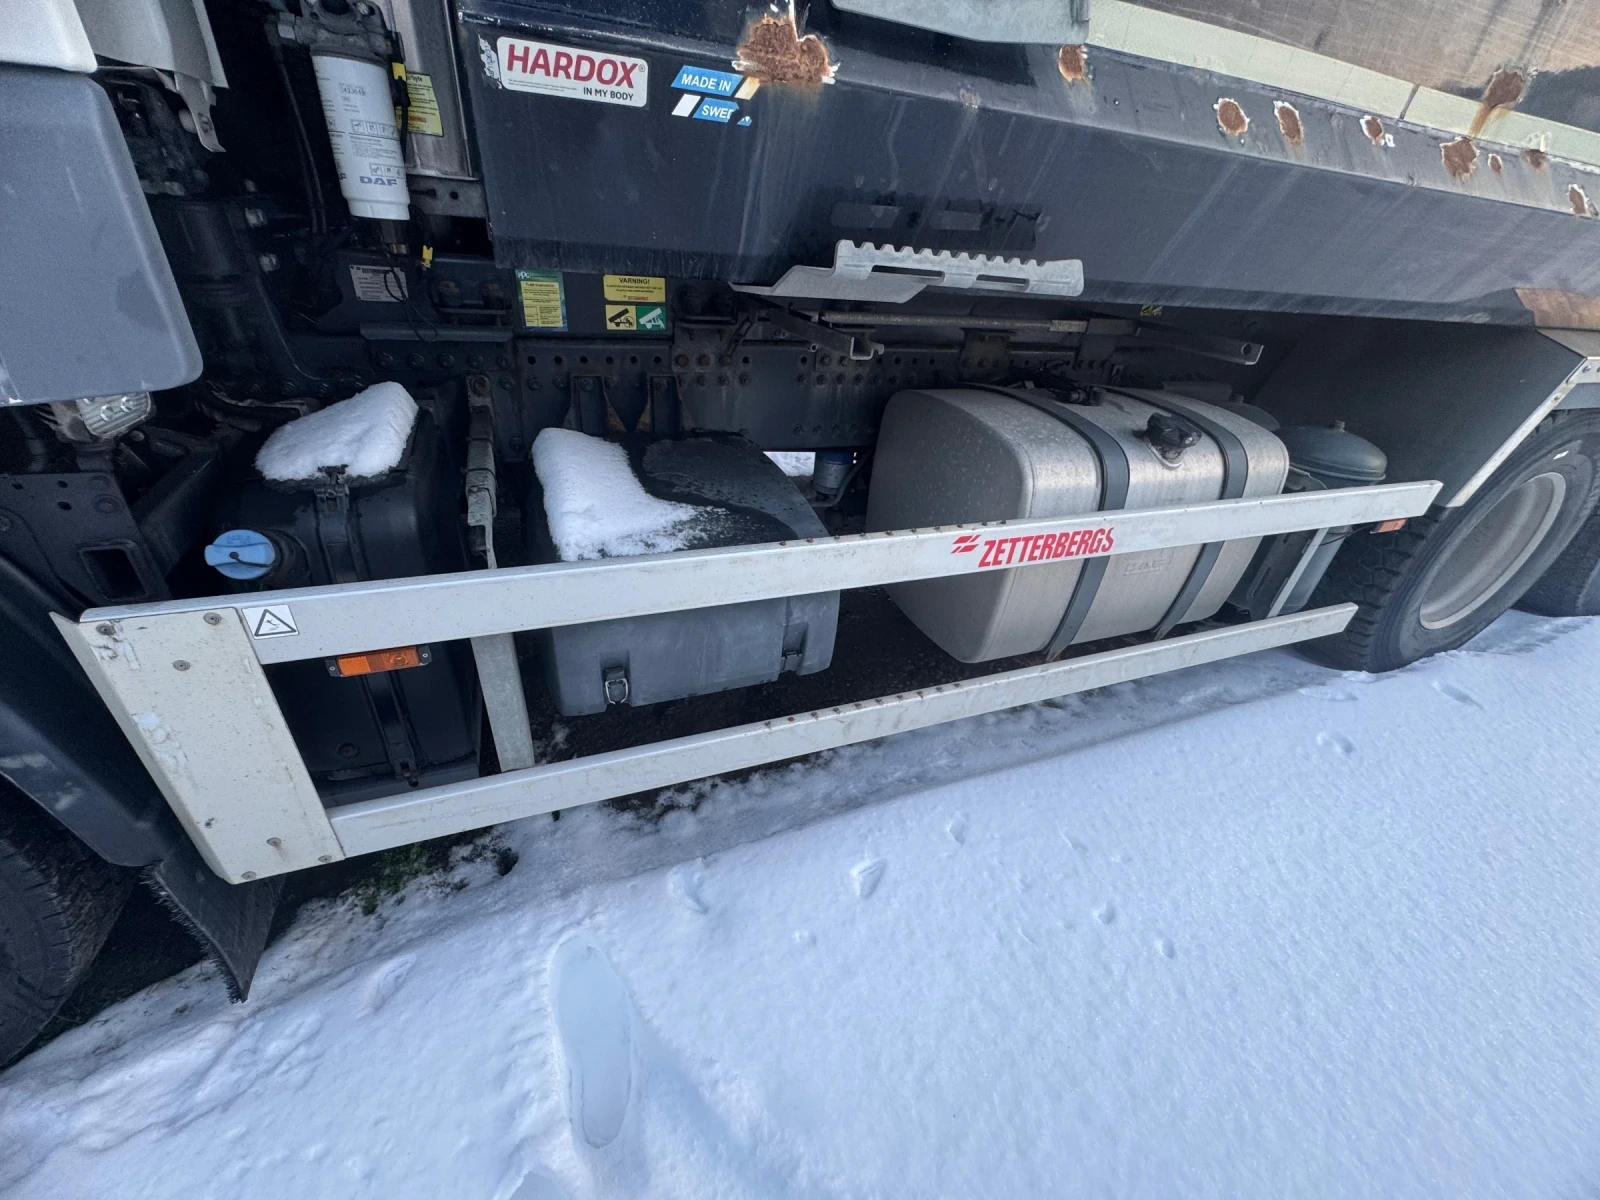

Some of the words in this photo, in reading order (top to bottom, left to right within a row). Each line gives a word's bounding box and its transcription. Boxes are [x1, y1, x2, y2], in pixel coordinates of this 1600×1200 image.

[681, 73, 717, 90] MADE
[718, 79, 732, 92] IN
[583, 86, 593, 96] IN
[594, 88, 608, 98] MY
[610, 89, 634, 101] BODY
[359, 175, 398, 187] DAF
[619, 277, 650, 285] VARNING!
[977, 526, 1115, 568] ZETTERBERGS
